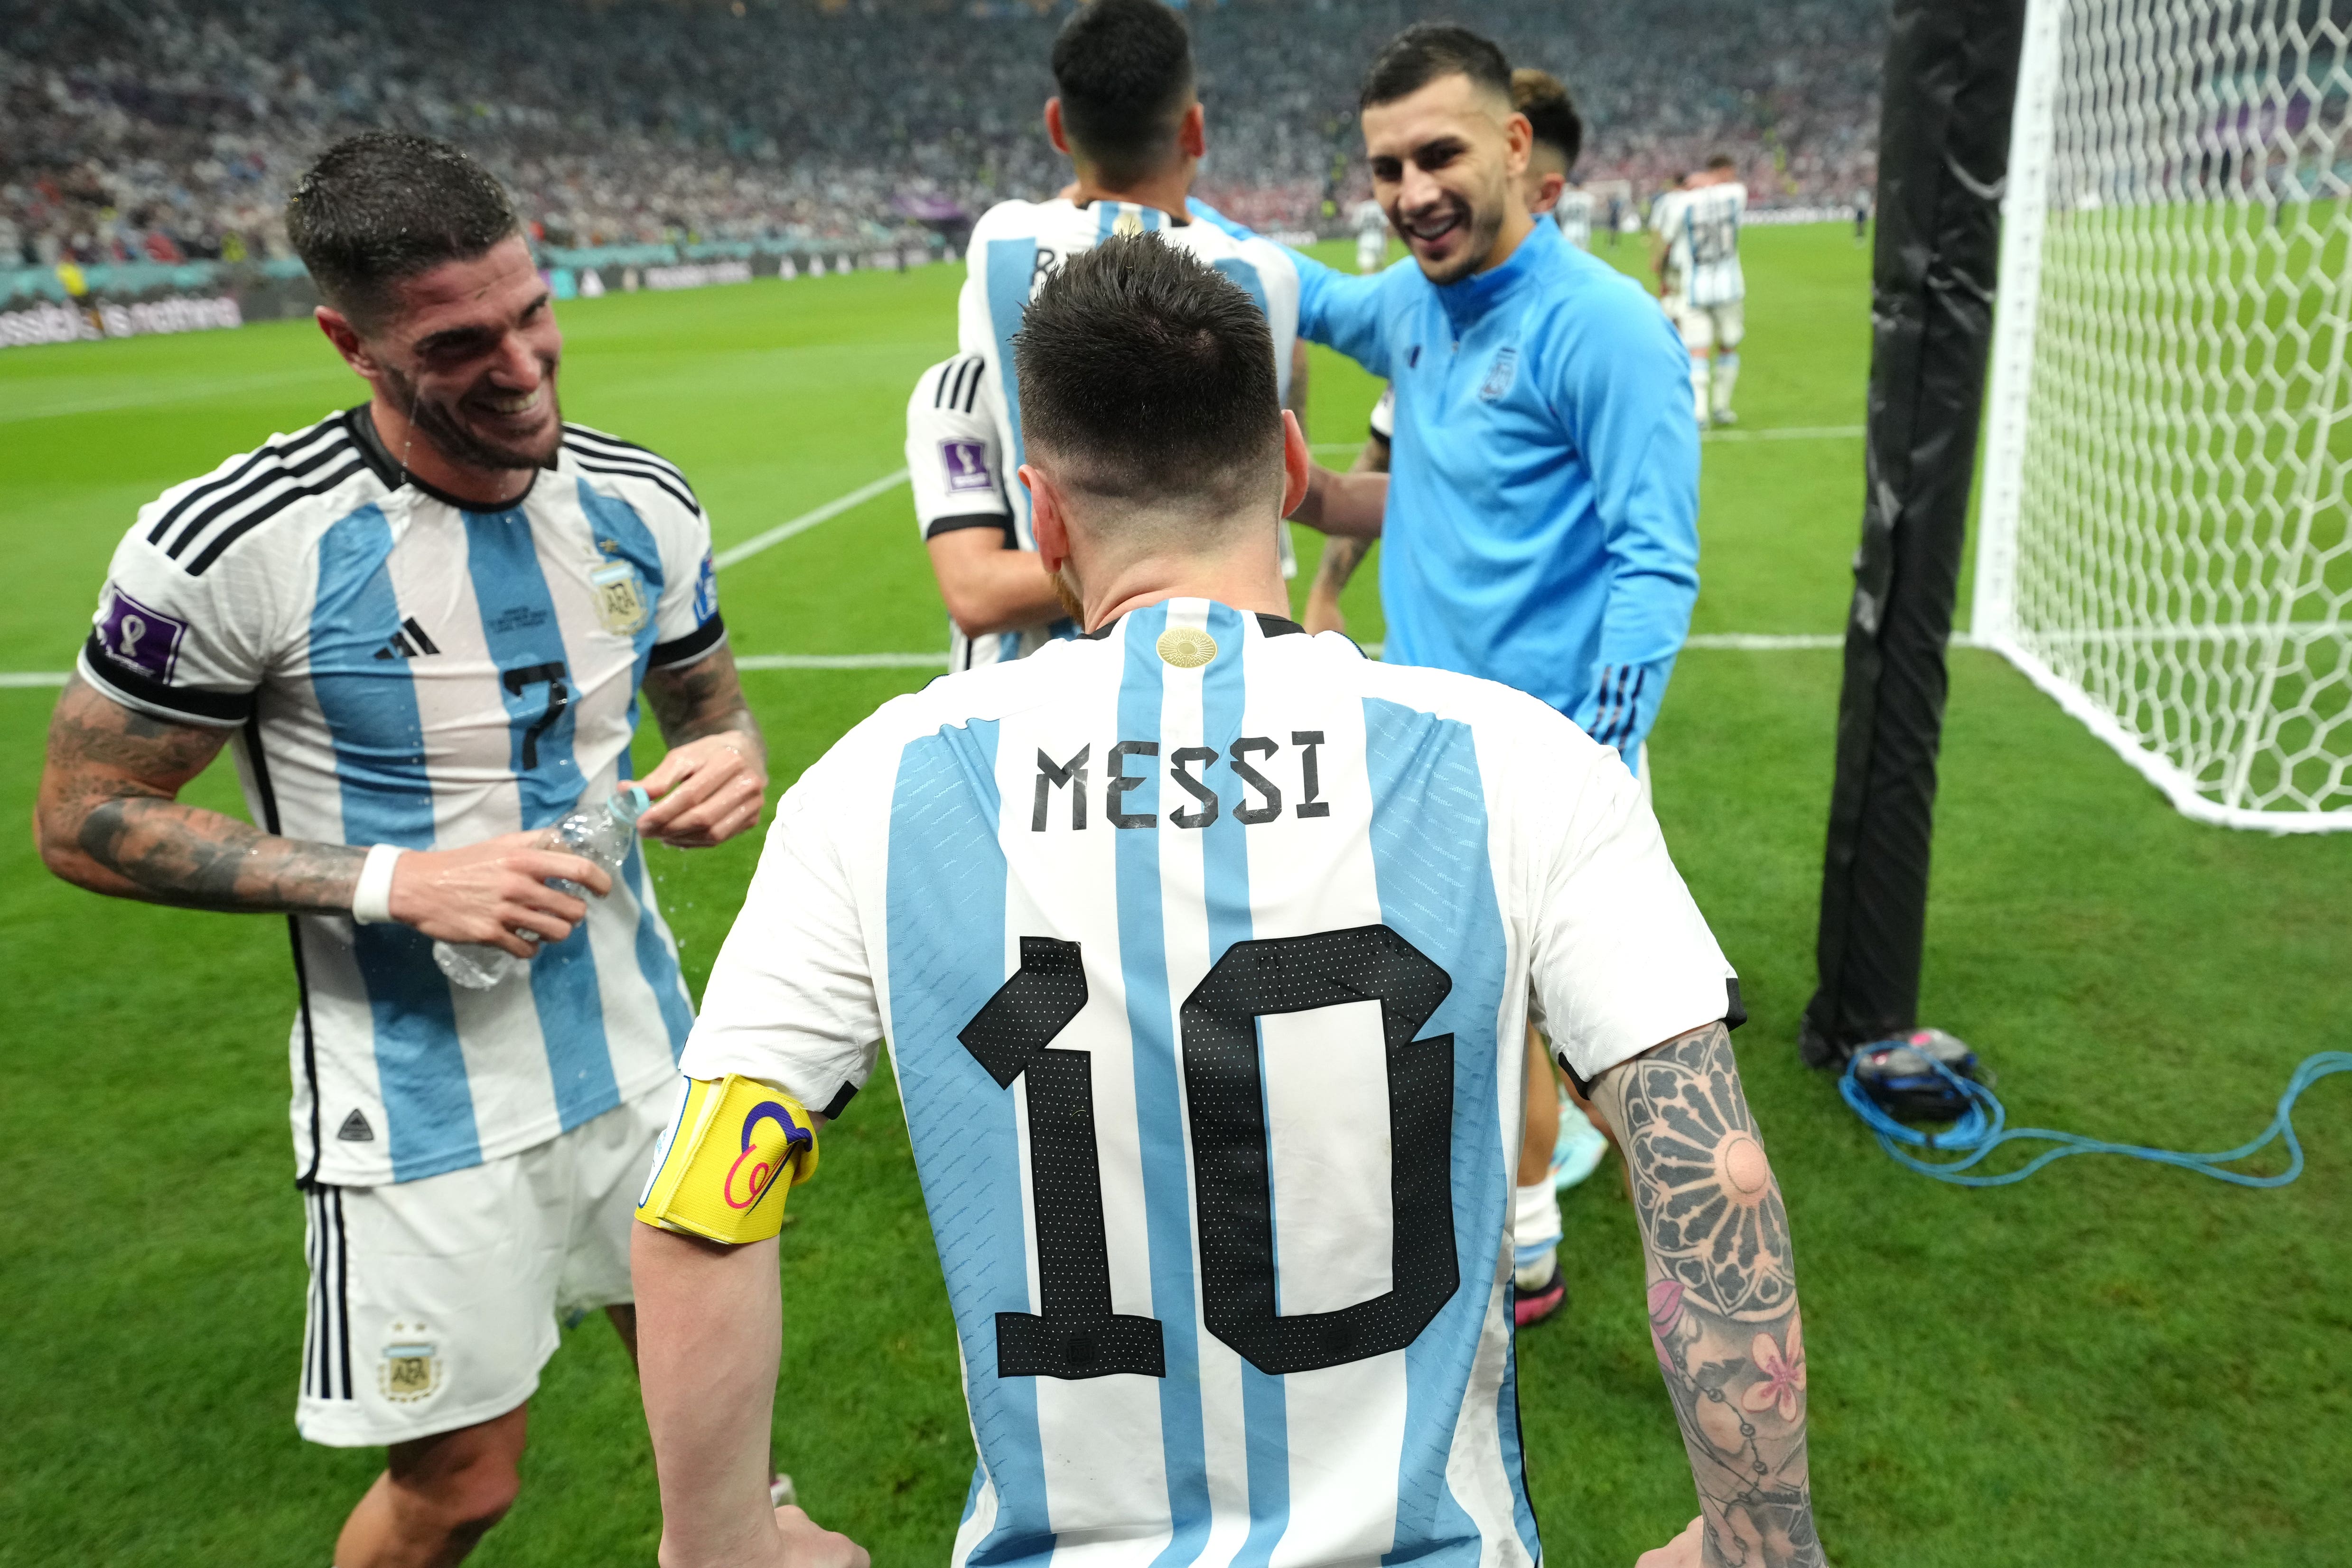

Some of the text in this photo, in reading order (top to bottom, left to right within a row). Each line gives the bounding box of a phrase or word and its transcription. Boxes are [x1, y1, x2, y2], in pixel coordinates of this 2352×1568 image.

[504, 662, 568, 771] 7
[1031, 730, 1330, 832] MESSI
[956, 924, 1460, 1380] 10
